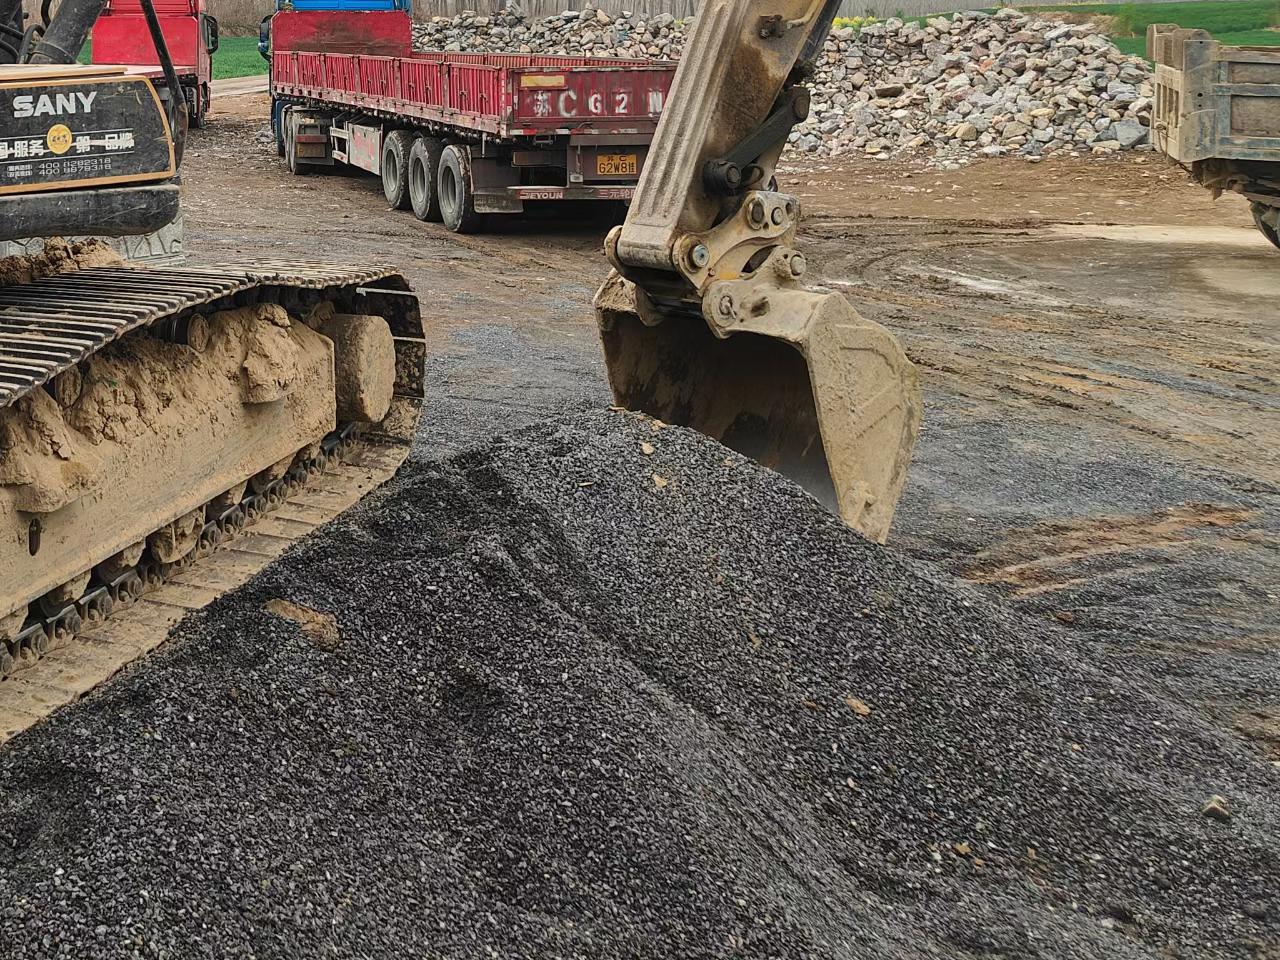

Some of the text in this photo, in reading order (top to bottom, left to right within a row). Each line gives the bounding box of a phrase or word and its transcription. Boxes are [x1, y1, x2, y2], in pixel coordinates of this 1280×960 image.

[13, 91, 98, 118] SANY
[39, 162, 60, 170] 400
[39, 168, 60, 176] 400
